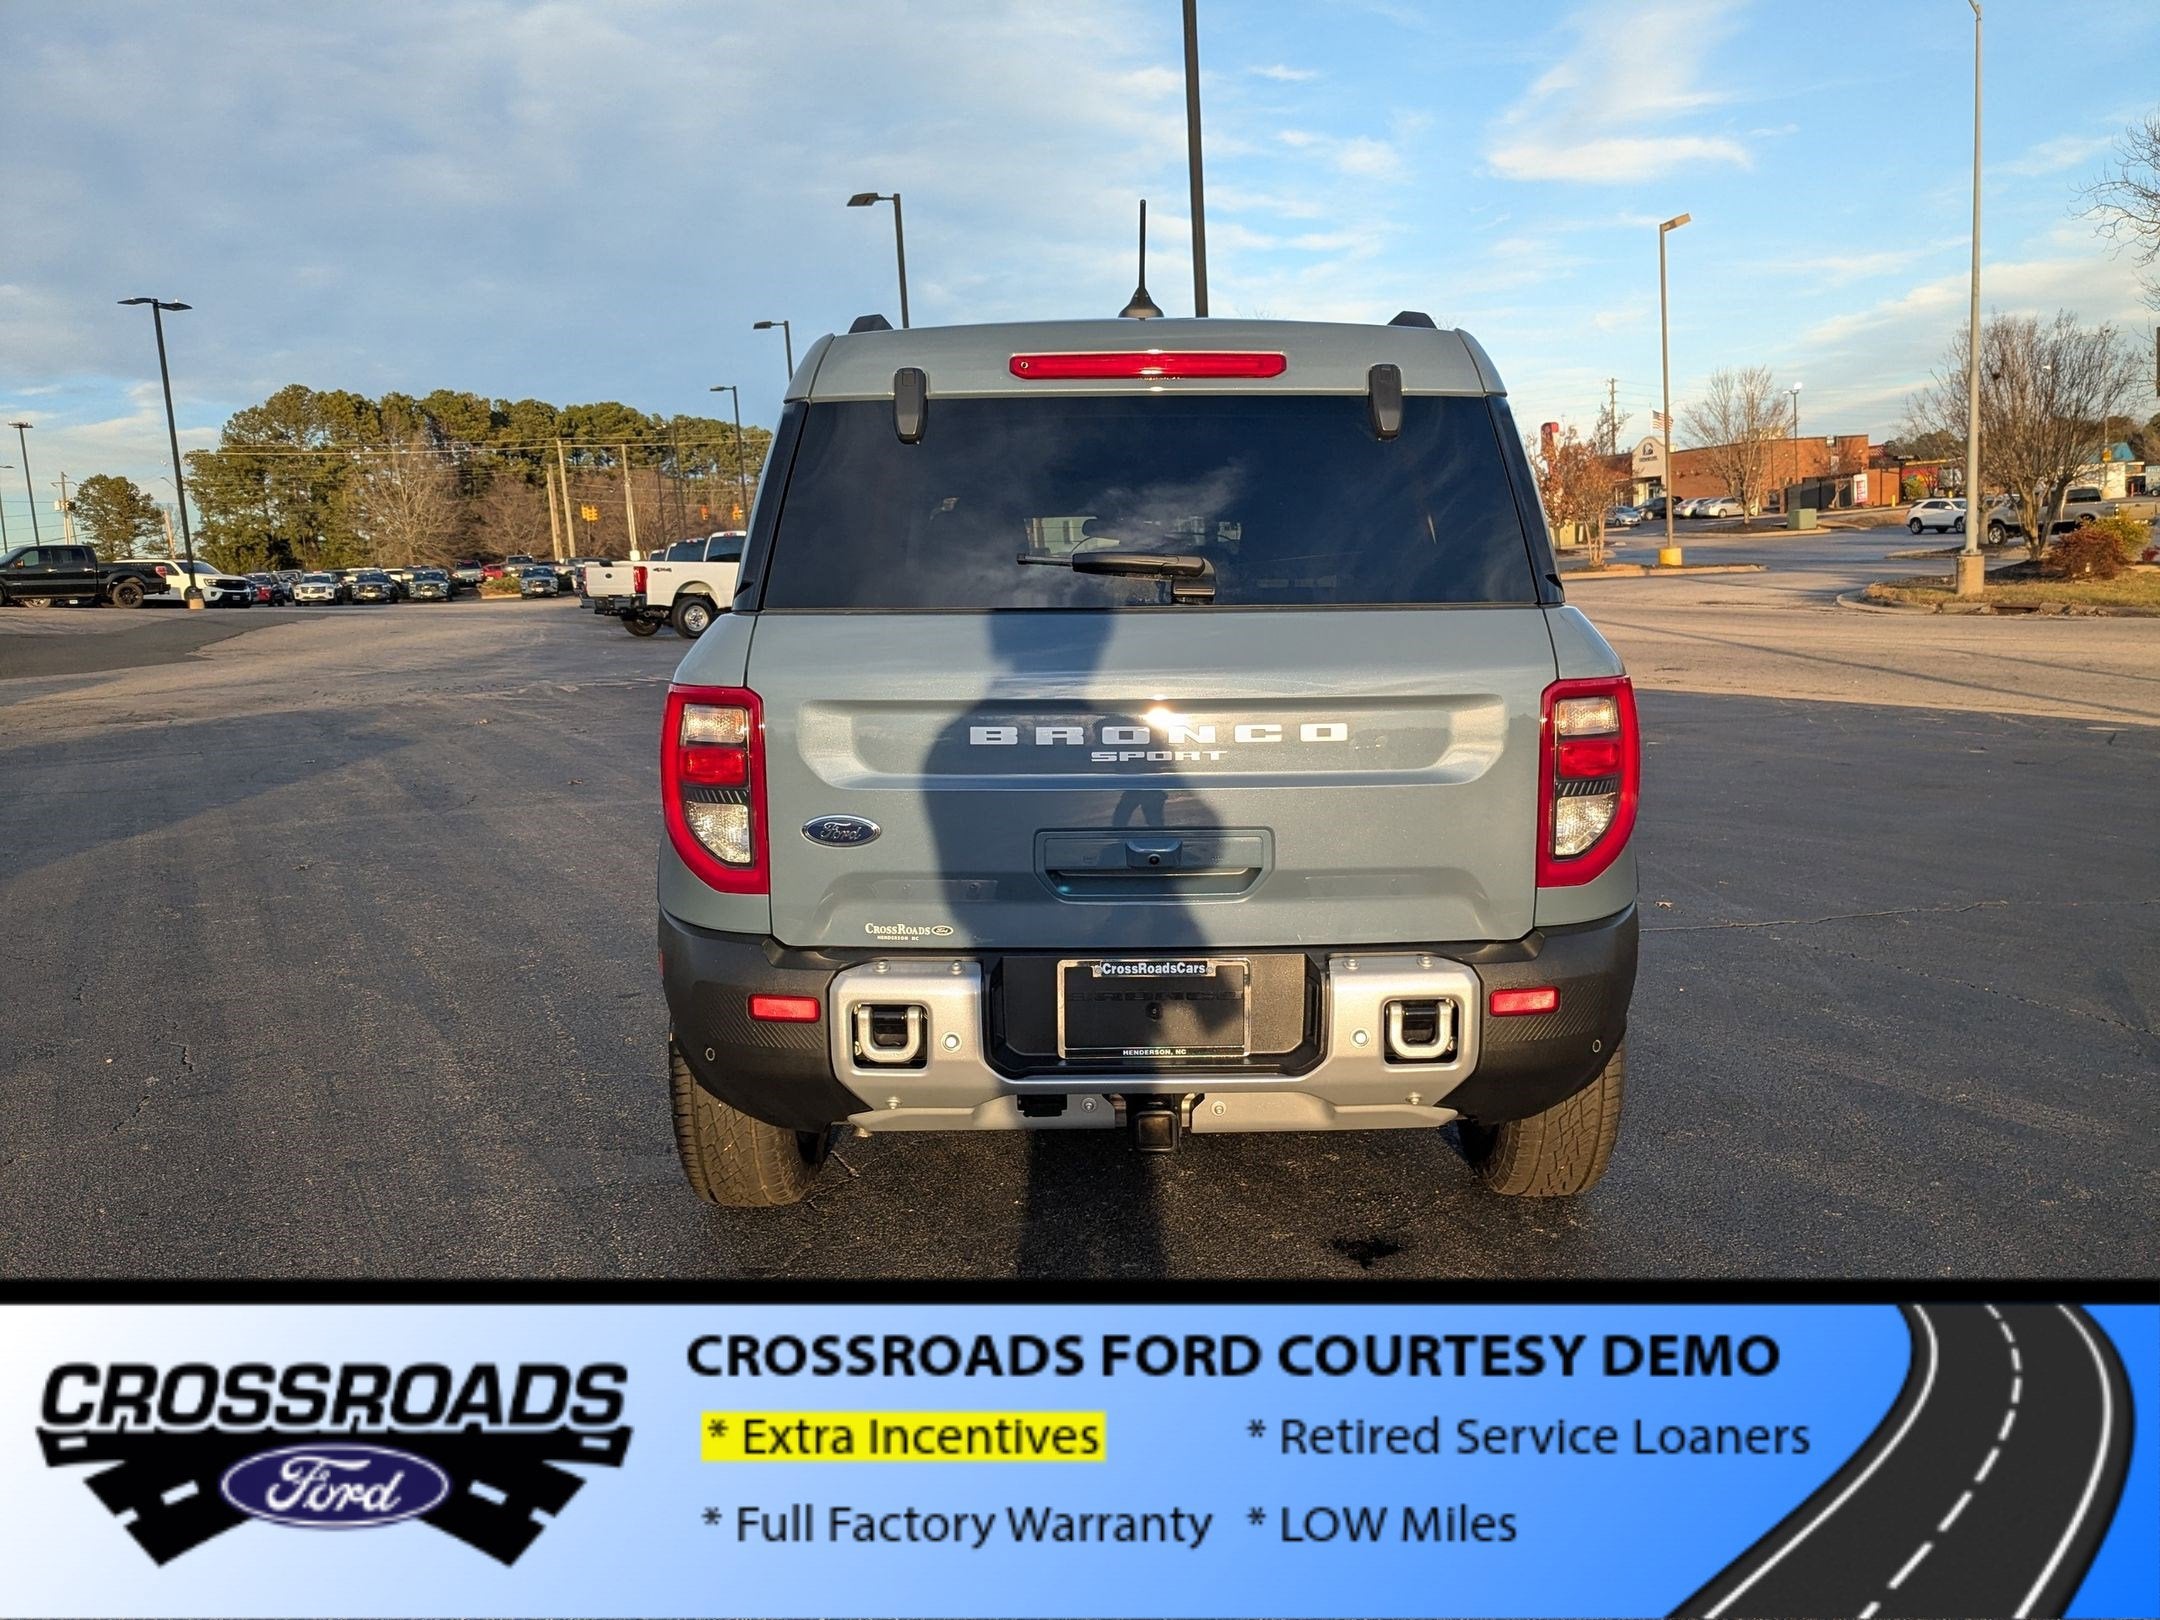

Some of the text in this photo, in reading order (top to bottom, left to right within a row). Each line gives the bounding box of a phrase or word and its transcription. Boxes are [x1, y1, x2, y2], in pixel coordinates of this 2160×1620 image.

[969, 722, 1348, 745] BRONCO
[1091, 750, 1228, 762] SPORT
[820, 821, 862, 840] Ford
[1101, 962, 1206, 975] CrossRoadsCars
